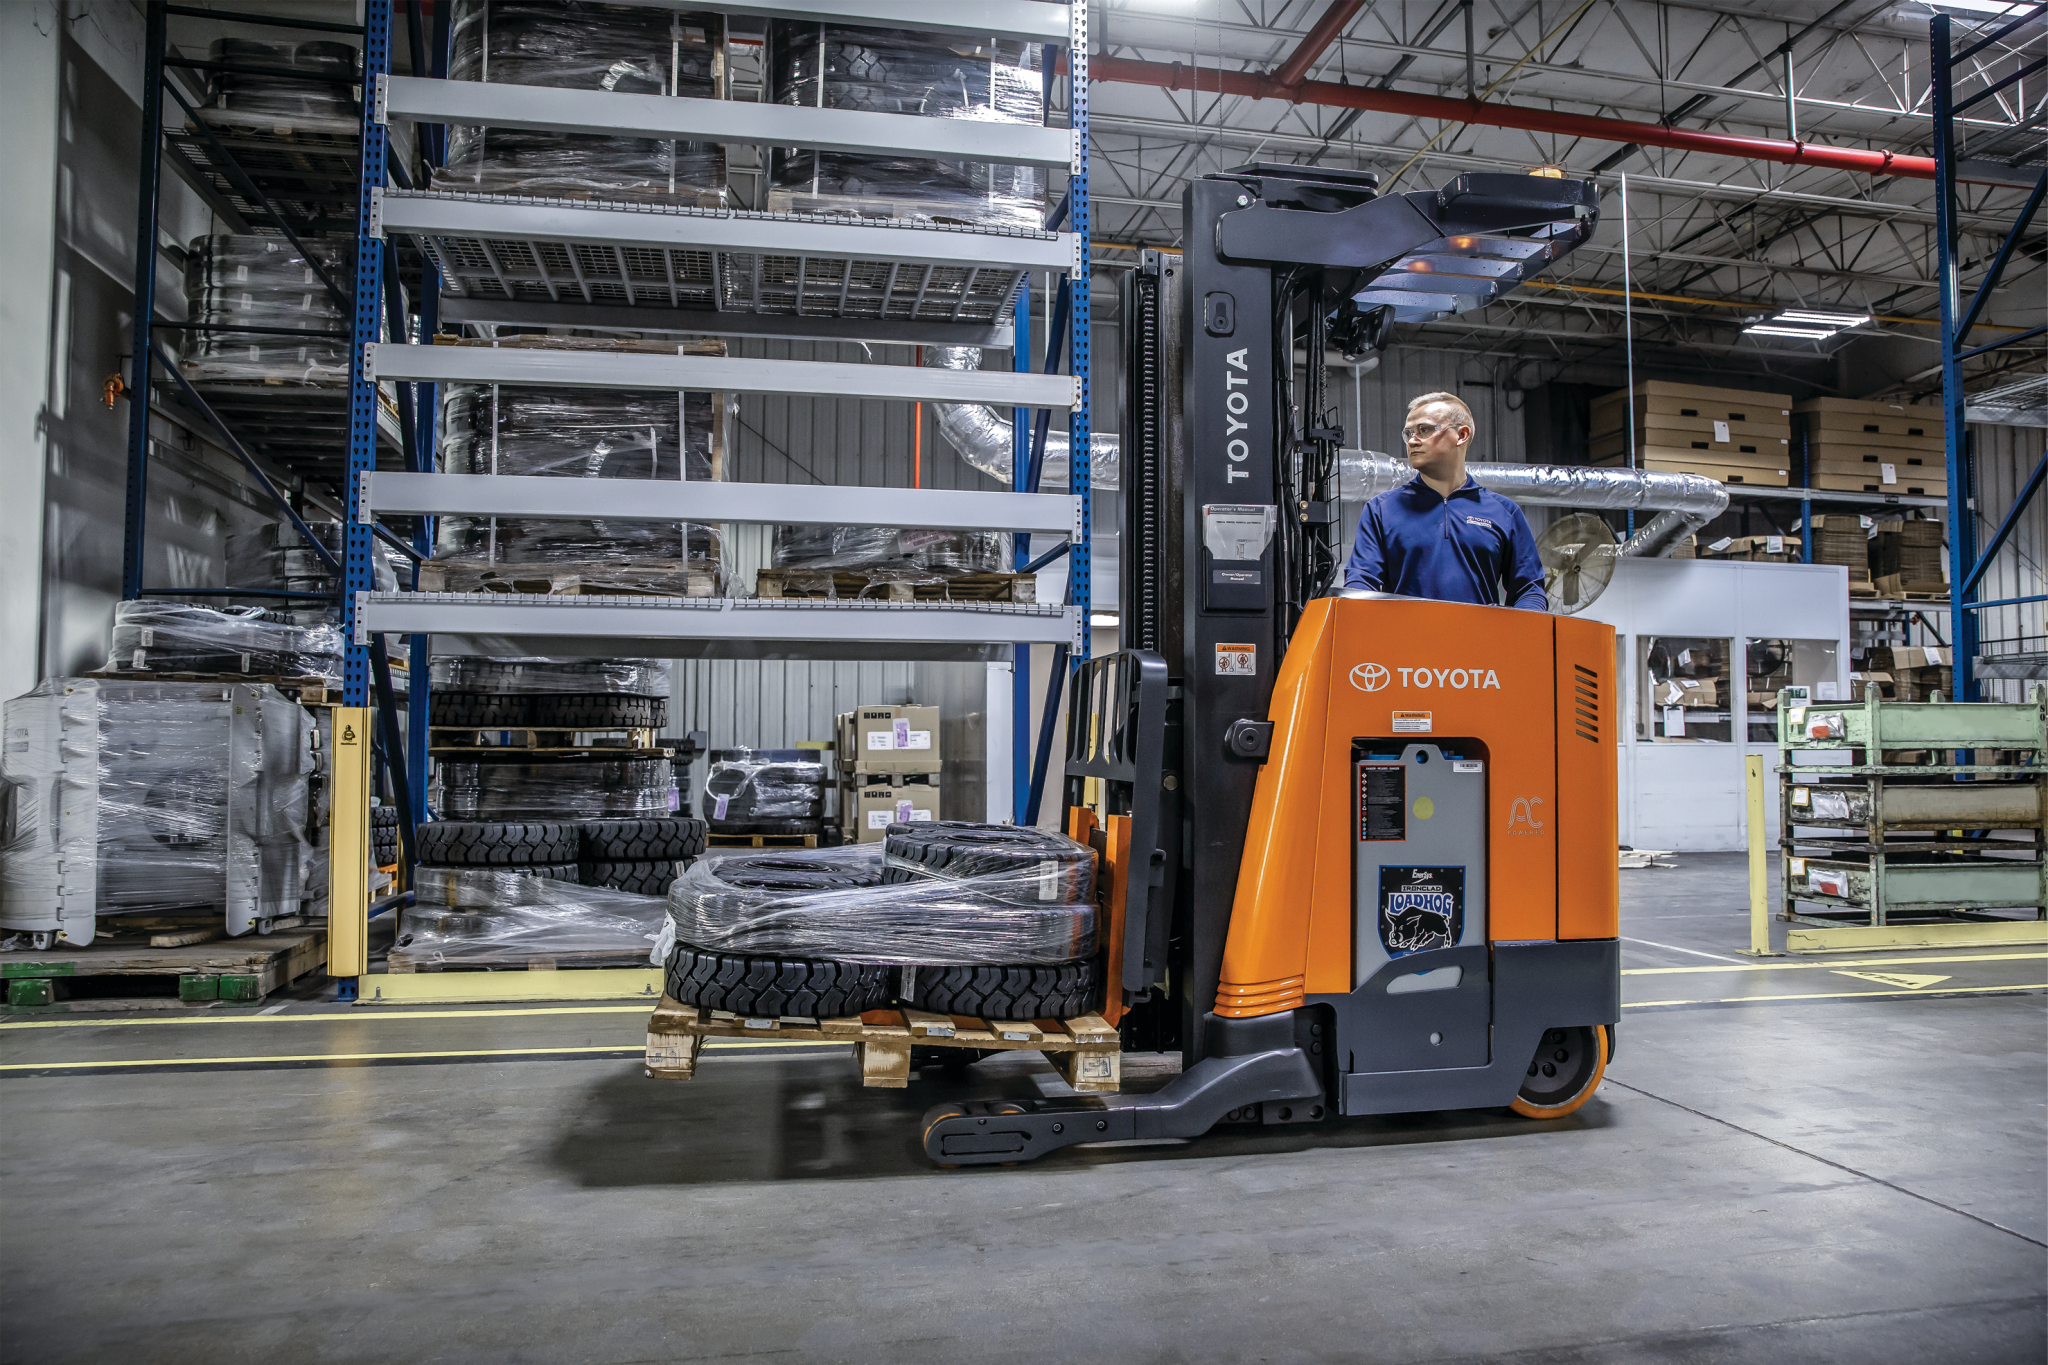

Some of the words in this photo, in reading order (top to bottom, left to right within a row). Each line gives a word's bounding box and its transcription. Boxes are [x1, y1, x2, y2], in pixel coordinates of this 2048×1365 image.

[1226, 347, 1249, 484] TOYOTA
[1397, 667, 1501, 689] TOYOTA
[1507, 796, 1544, 829] AC
[1388, 892, 1454, 919] LOADHOG
